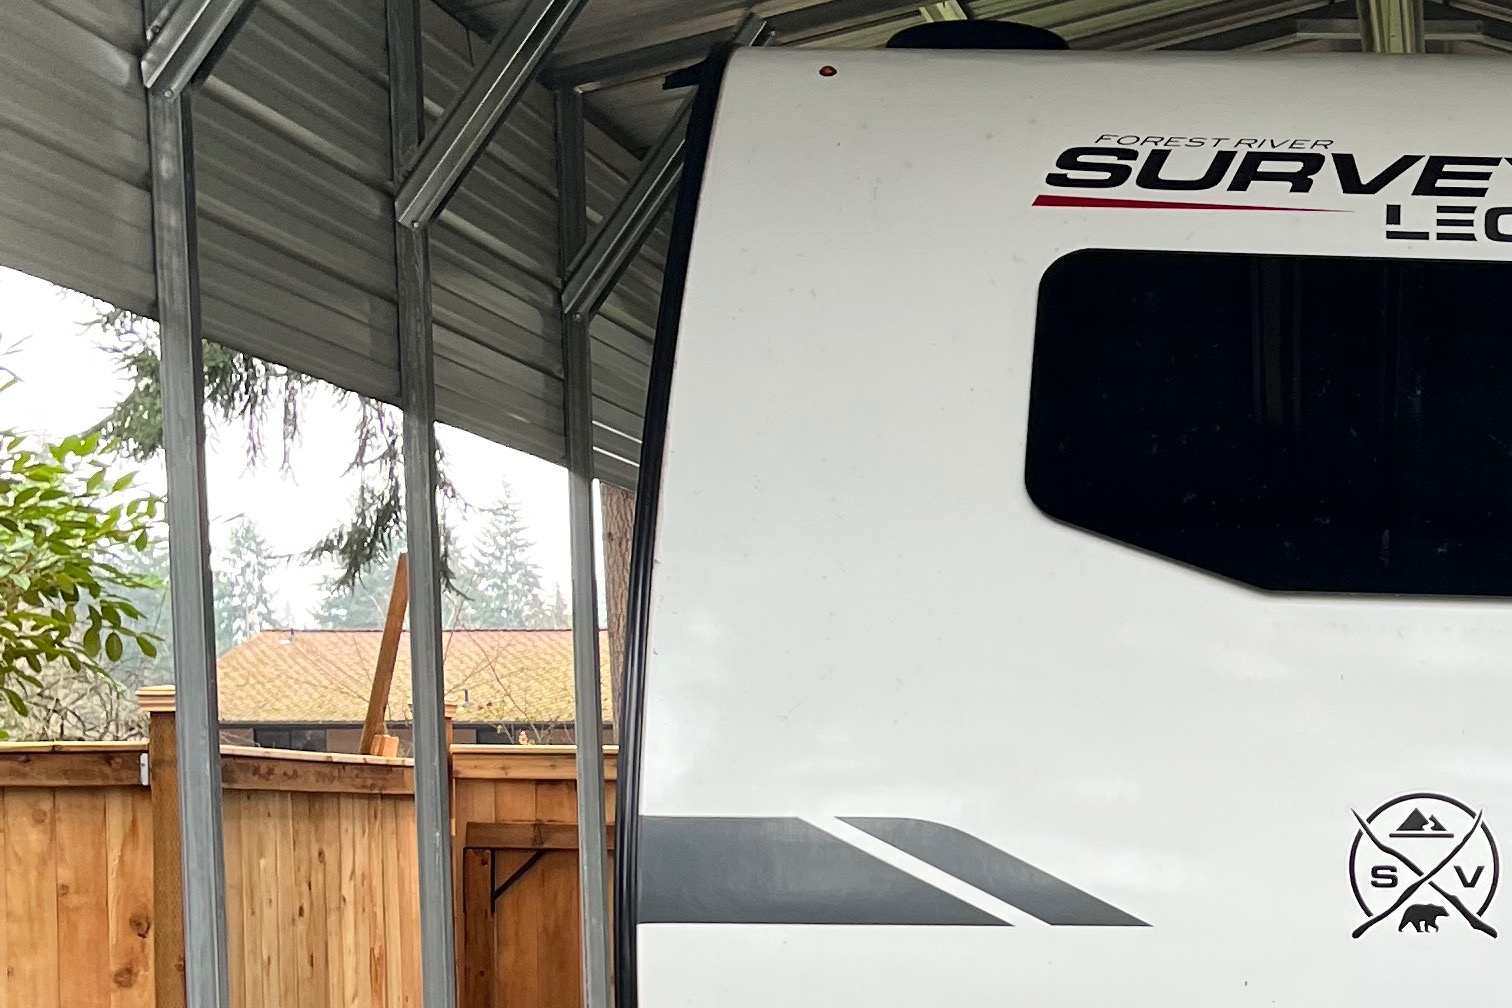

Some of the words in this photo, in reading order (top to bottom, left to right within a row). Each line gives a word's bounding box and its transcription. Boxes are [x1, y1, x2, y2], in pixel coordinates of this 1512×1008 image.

[1095, 133, 1230, 148] FOREST
[1233, 138, 1334, 150] RIVER
[1370, 865, 1399, 889] S
[1453, 865, 1485, 889] V
